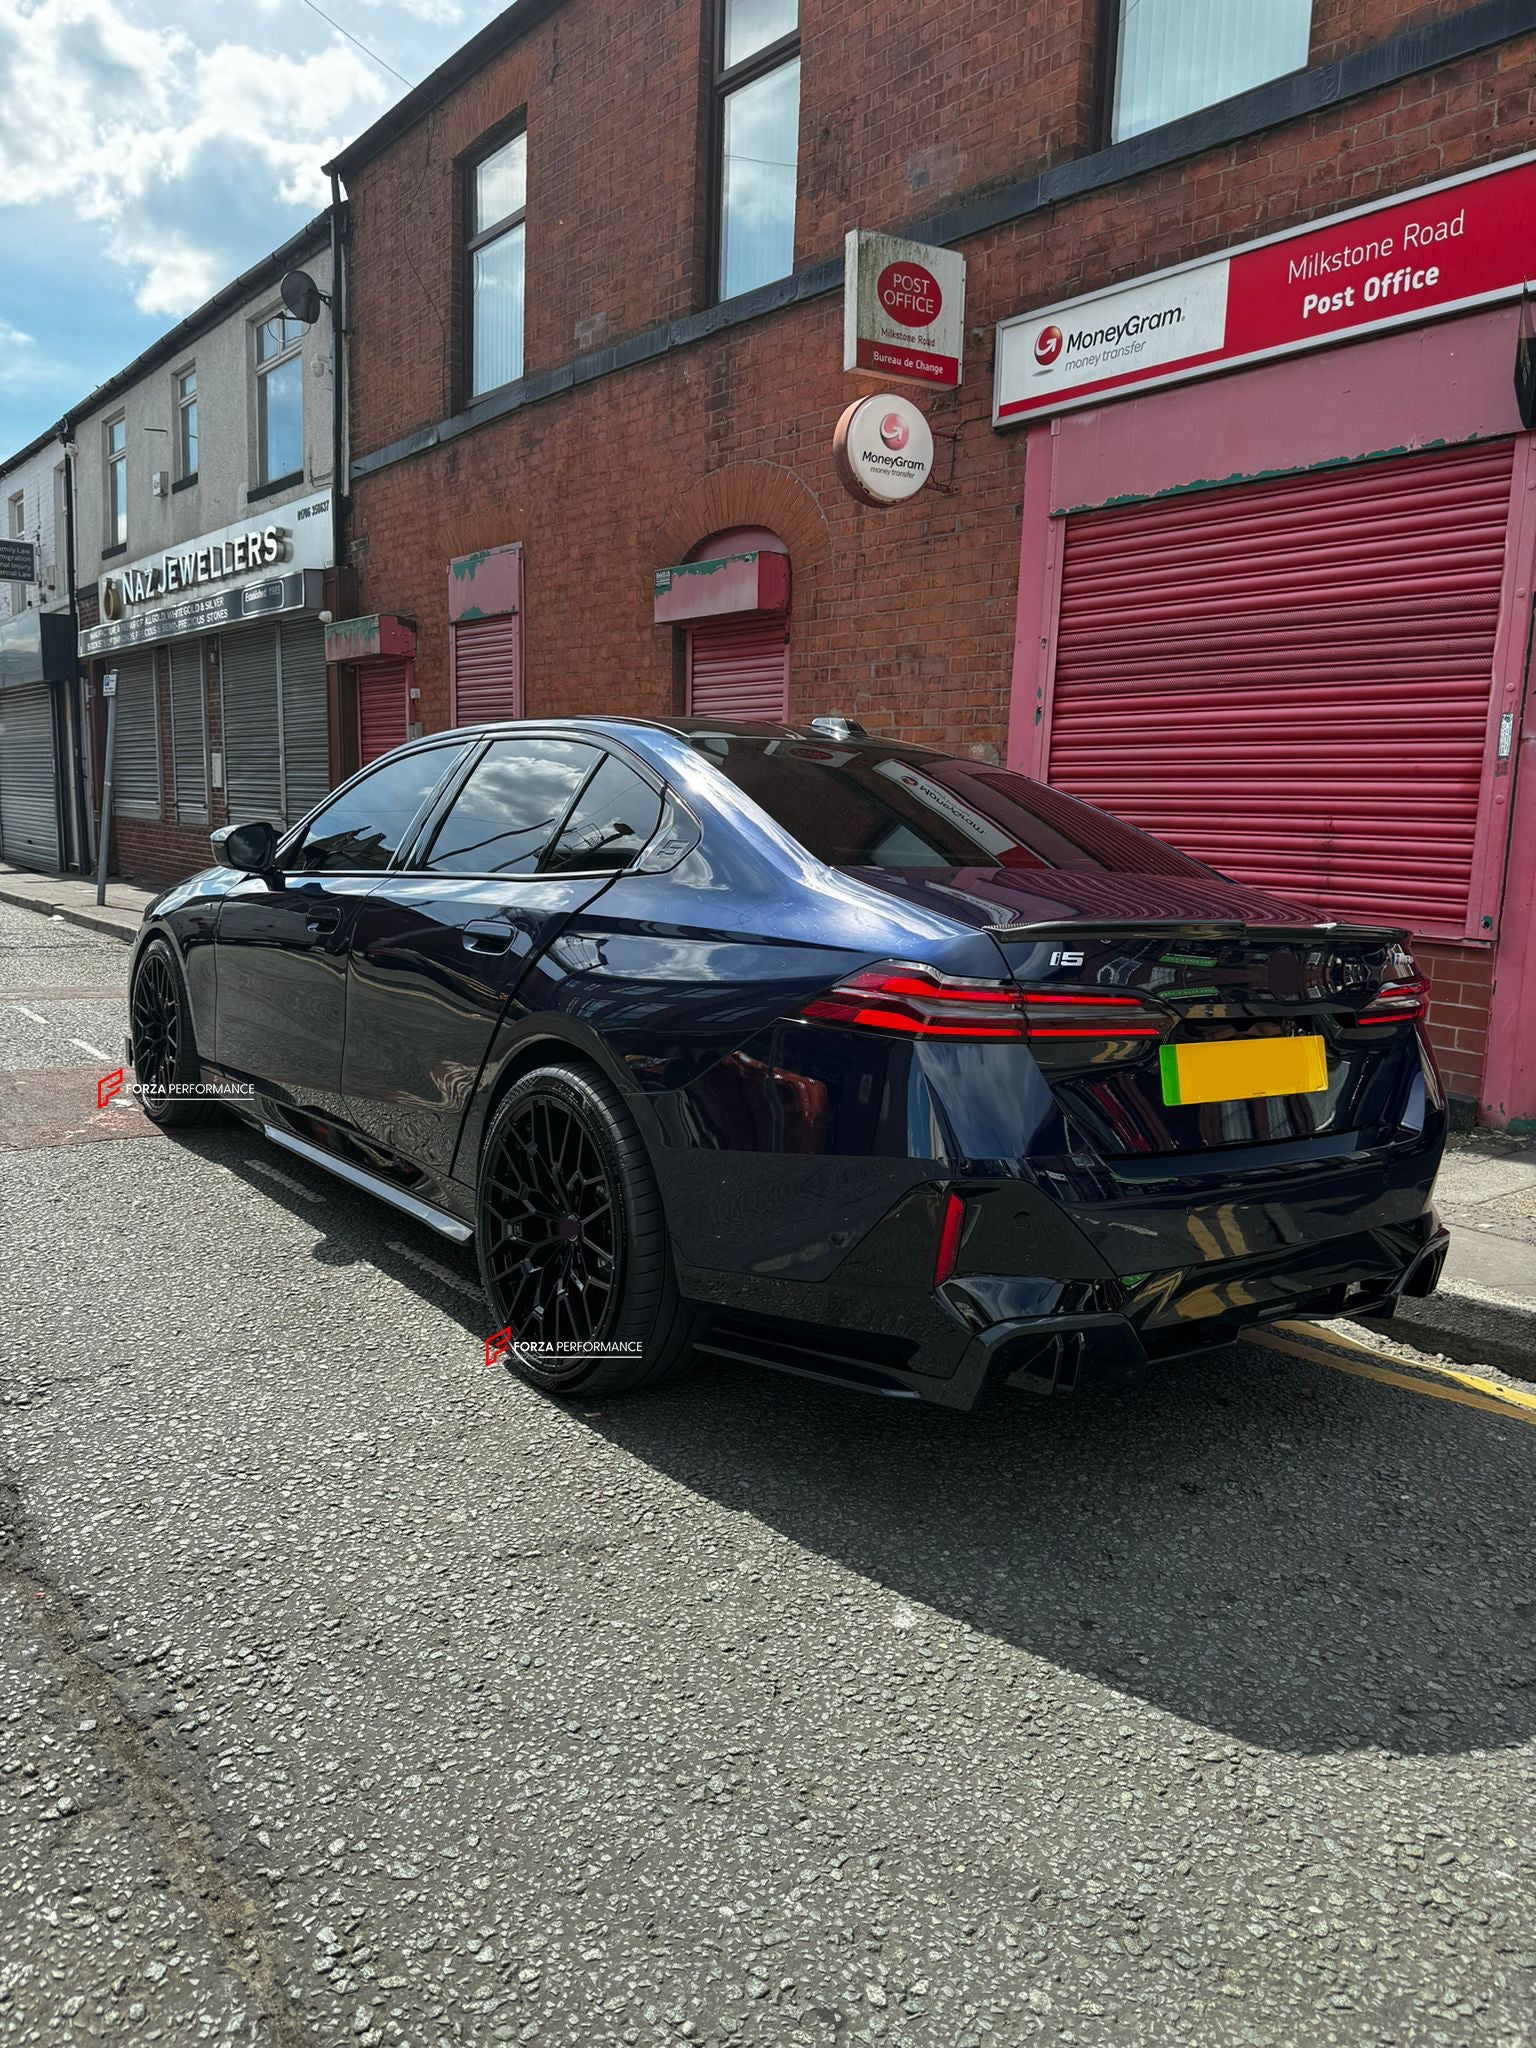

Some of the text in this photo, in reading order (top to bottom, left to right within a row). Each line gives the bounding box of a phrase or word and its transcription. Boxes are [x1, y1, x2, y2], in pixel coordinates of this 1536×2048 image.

[1288, 208, 1465, 285] Milkstone Road
[893, 273, 930, 294] POST
[1303, 266, 1440, 319] Post Office
[883, 289, 934, 314] OFFICE
[881, 328, 936, 347] Milkstone Road
[1066, 307, 1183, 353] MoneyGram
[873, 351, 944, 375] Bureau de Change
[1065, 340, 1147, 372] money transfer
[862, 451, 925, 471] MoneyGram
[870, 466, 916, 479] money transfer
[122, 525, 278, 605] NAZ JEWELLERS
[205, 596, 225, 610] SILVER
[206, 608, 228, 623] STONES
[1050, 951, 1085, 967] i5
